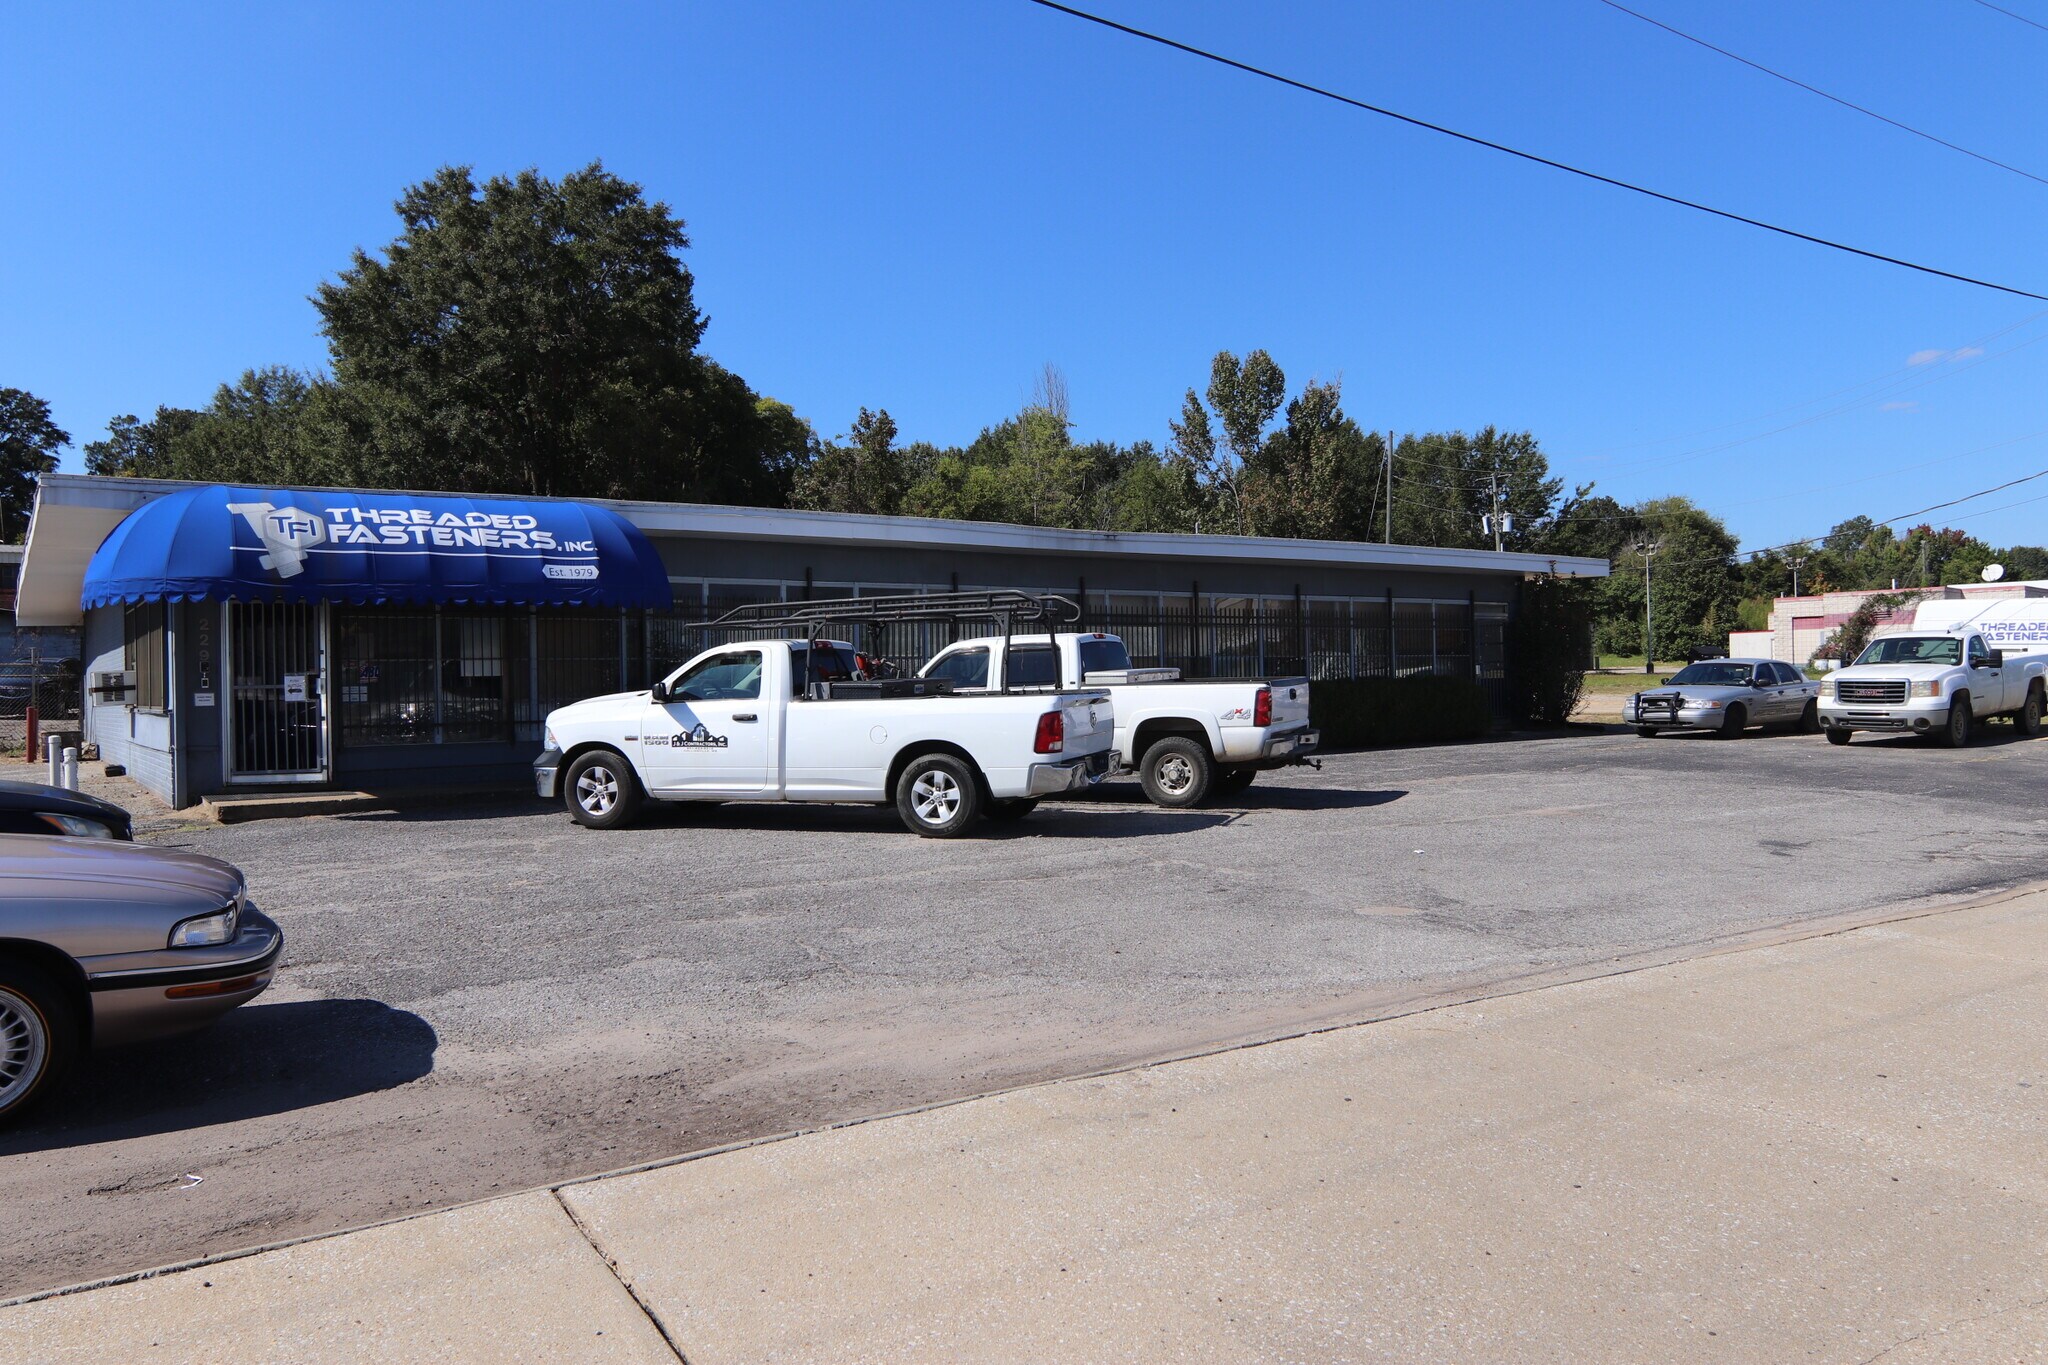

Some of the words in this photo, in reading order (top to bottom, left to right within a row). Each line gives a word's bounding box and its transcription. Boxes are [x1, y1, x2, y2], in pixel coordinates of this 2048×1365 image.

[325, 507, 538, 530] THREADED
[268, 516, 317, 540] TFI
[564, 540, 598, 552] INC.
[548, 567, 566, 577] Est.
[569, 568, 593, 577] 1979
[1980, 622, 2048, 631] THREADE
